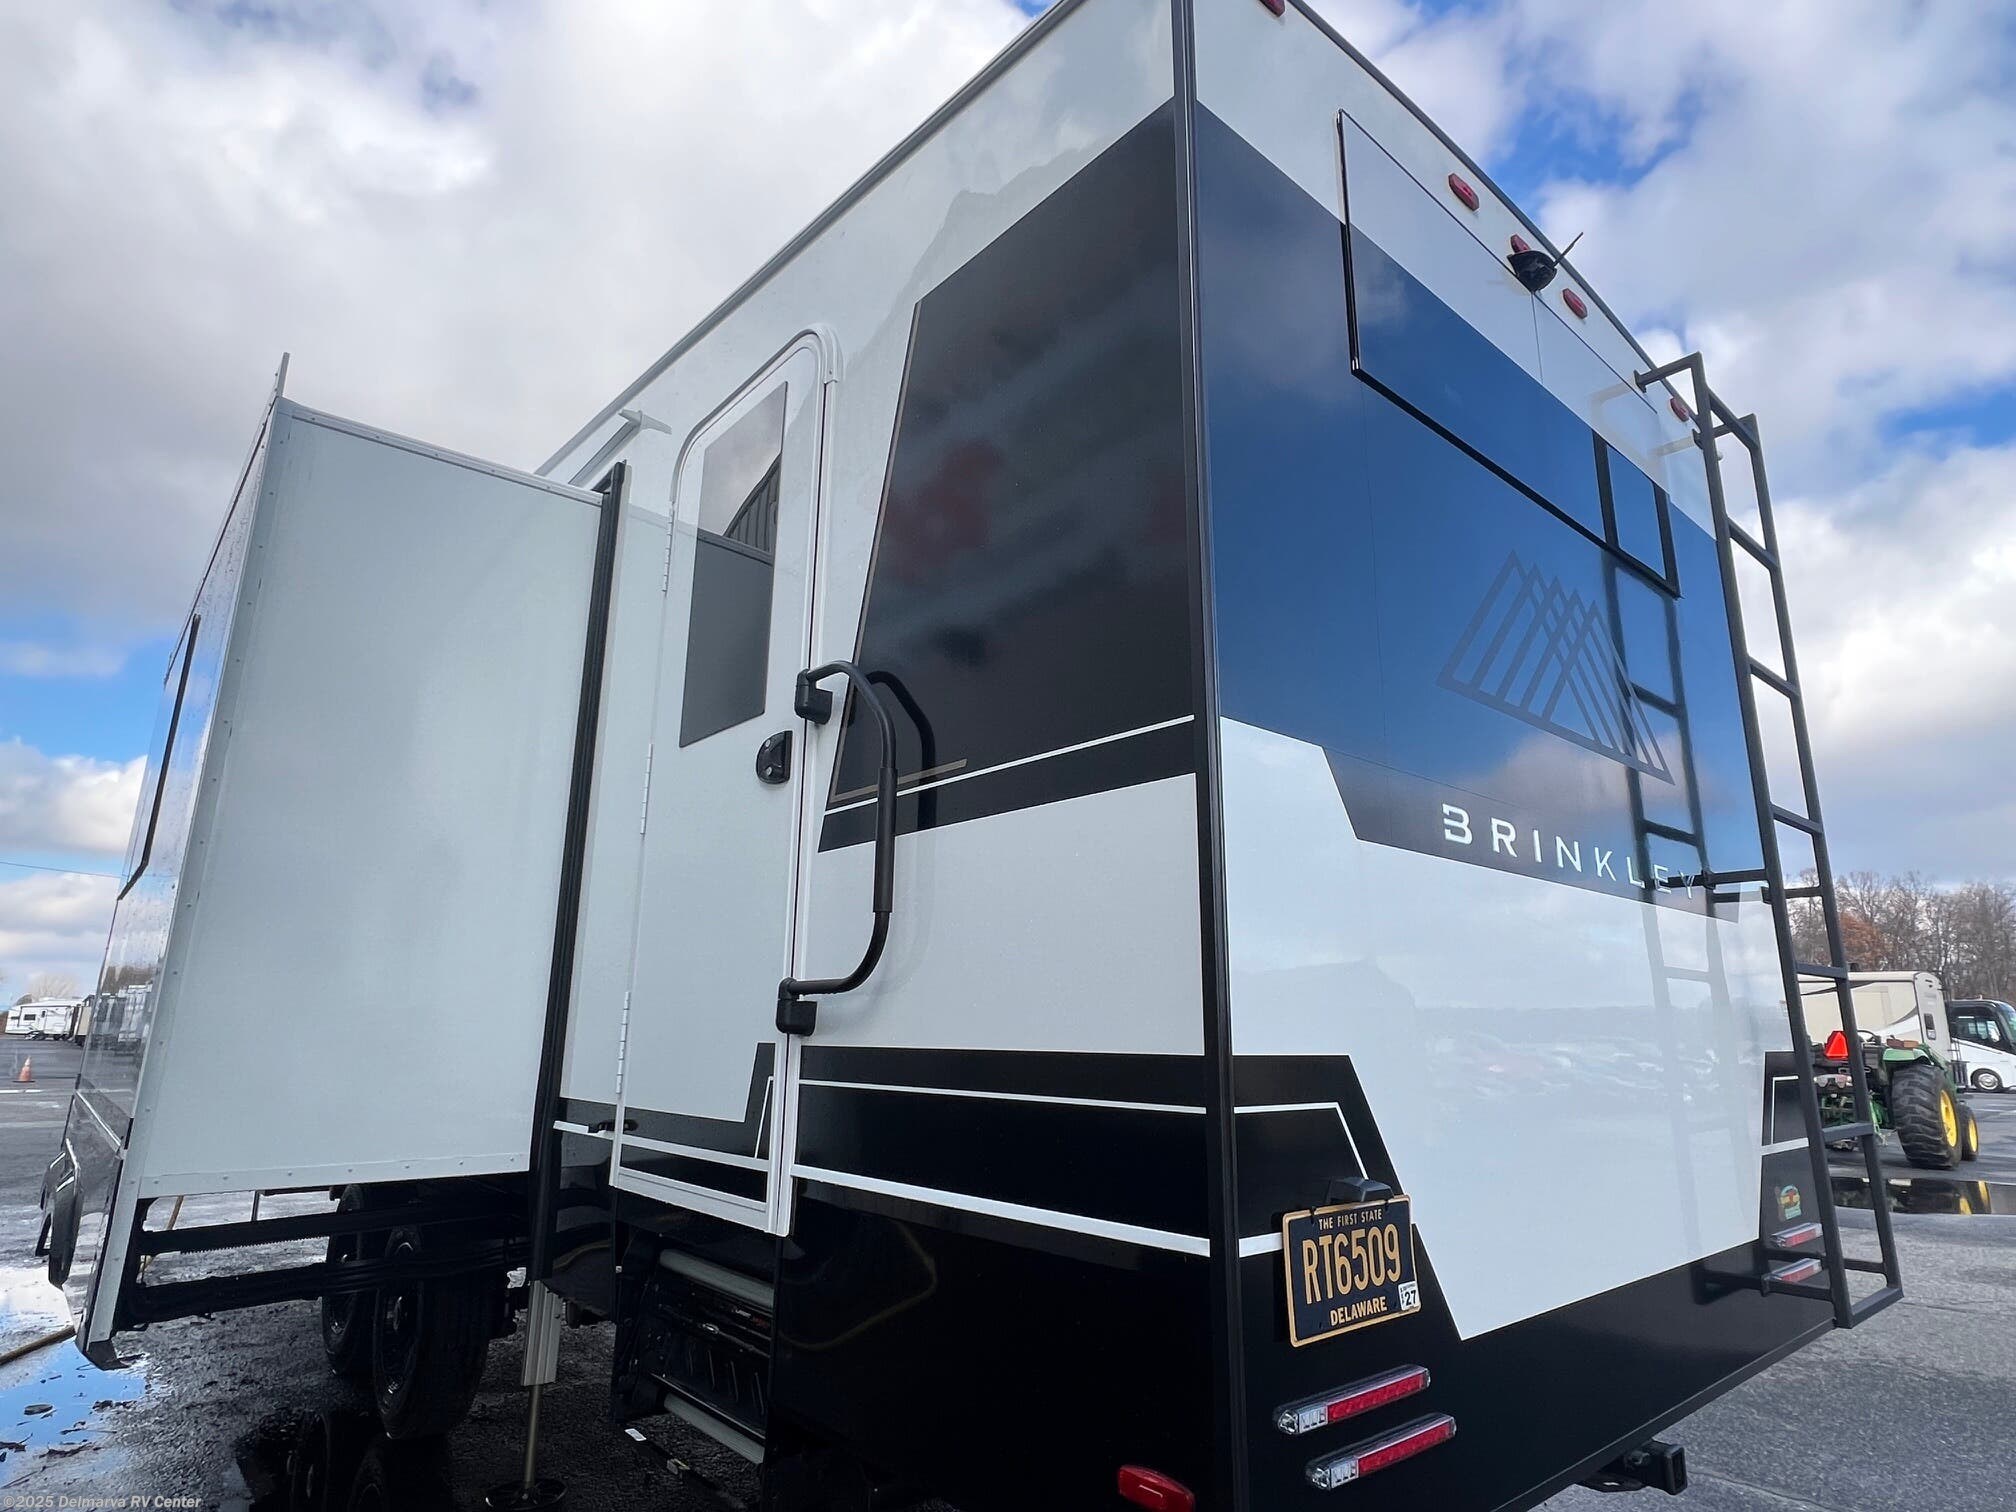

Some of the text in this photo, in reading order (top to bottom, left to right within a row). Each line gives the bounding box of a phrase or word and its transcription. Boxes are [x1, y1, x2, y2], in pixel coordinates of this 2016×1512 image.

[1442, 803, 1695, 899] BRINKLEY
[1318, 1208, 1382, 1231] THE FIRST STATE
[1302, 1223, 1401, 1305] RT6509
[1330, 1296, 1387, 1326] DELAWARE
[1404, 1289, 1416, 1306] 27
